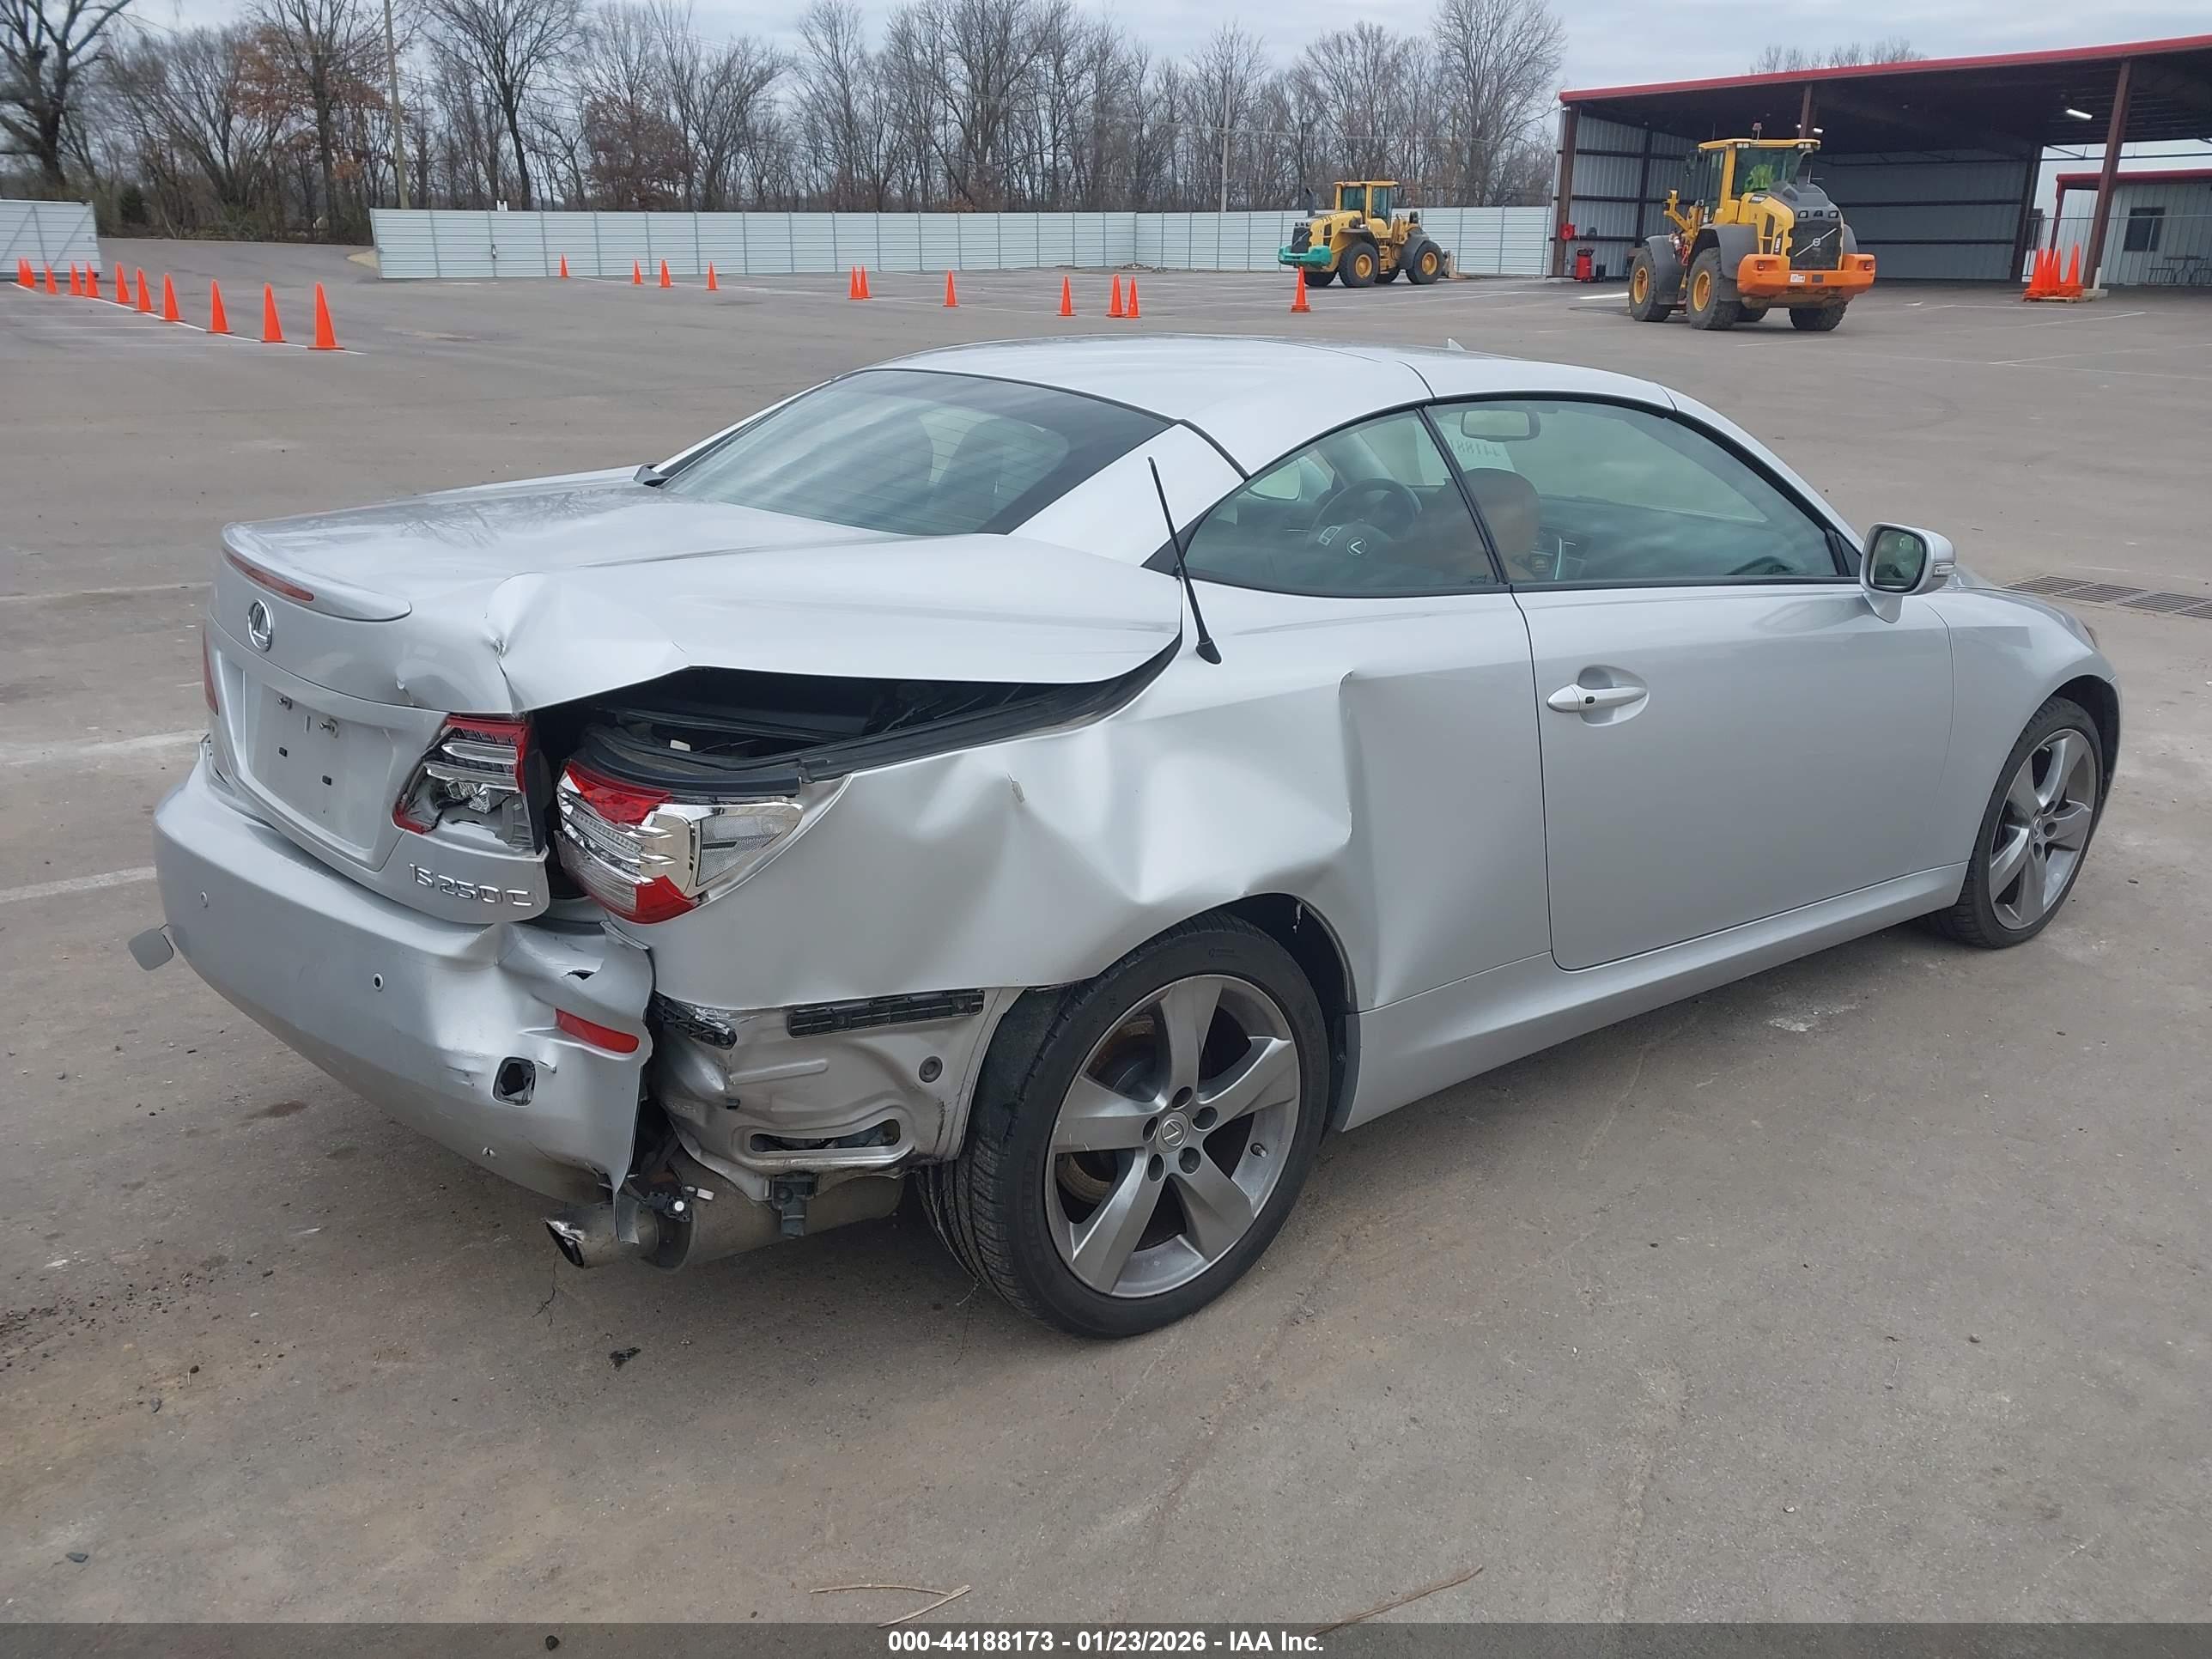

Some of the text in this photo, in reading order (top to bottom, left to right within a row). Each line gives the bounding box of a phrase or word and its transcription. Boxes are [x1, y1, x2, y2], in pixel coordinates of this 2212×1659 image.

[409, 862, 533, 907] IS 250 C
